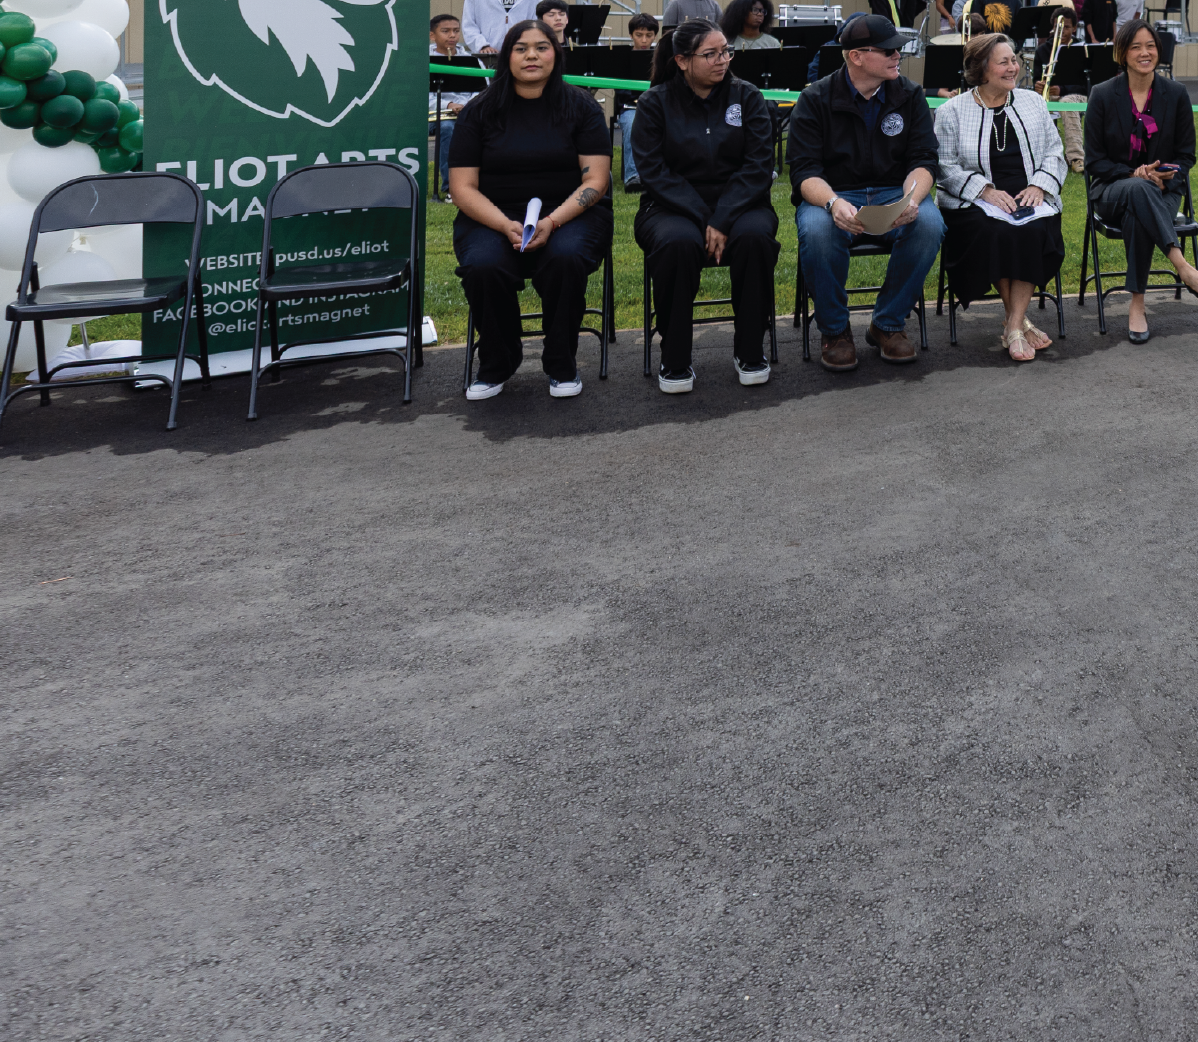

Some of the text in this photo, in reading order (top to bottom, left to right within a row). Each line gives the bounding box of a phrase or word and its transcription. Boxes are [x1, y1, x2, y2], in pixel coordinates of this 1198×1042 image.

[276, 240, 389, 266] pusd.us/eliot
[193, 278, 260, 298] ONNEC
[208, 303, 371, 337] @eliortsmagnet
